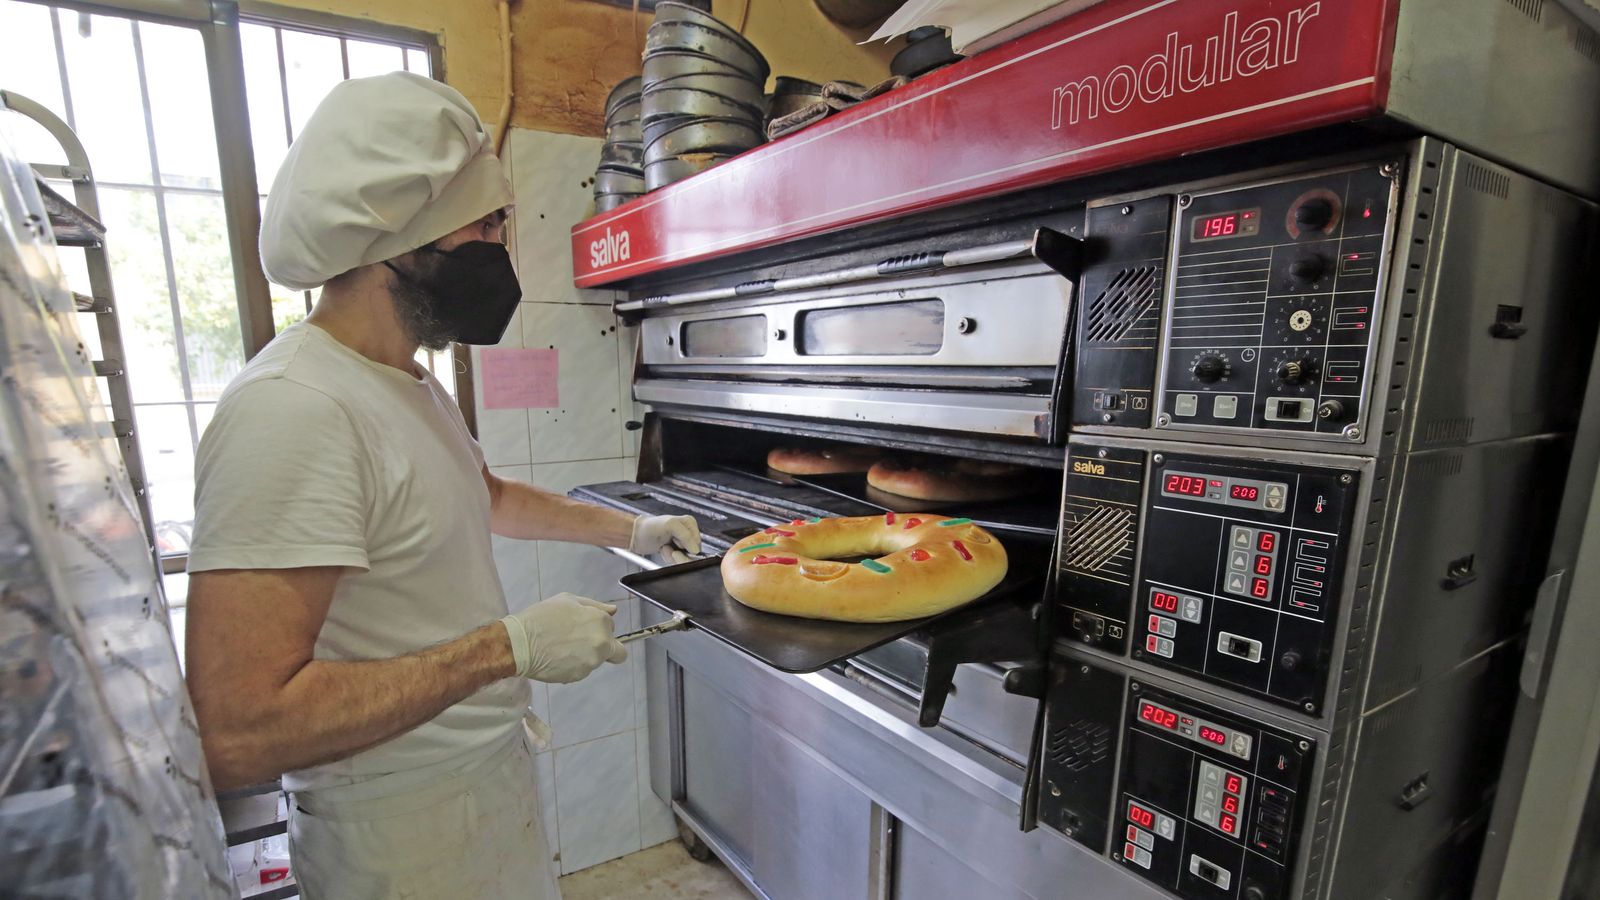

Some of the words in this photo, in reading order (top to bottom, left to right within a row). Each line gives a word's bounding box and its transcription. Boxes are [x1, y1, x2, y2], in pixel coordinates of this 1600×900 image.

[1052, 1, 1322, 130] modular
[1203, 216, 1235, 238] 196
[590, 227, 631, 268] salva
[1073, 460, 1105, 475] salva
[1167, 476, 1204, 495] 203
[1232, 487, 1257, 498] 208
[1260, 534, 1273, 550] 6
[1257, 557, 1270, 573] 6
[1254, 580, 1266, 596] 6
[1154, 593, 1177, 611] 00
[1142, 704, 1177, 728] 202
[1201, 729, 1225, 743] 208
[1227, 777, 1238, 793] 6
[1224, 797, 1236, 813] 6
[1130, 807, 1152, 826] 00
[1221, 817, 1233, 833] 6
